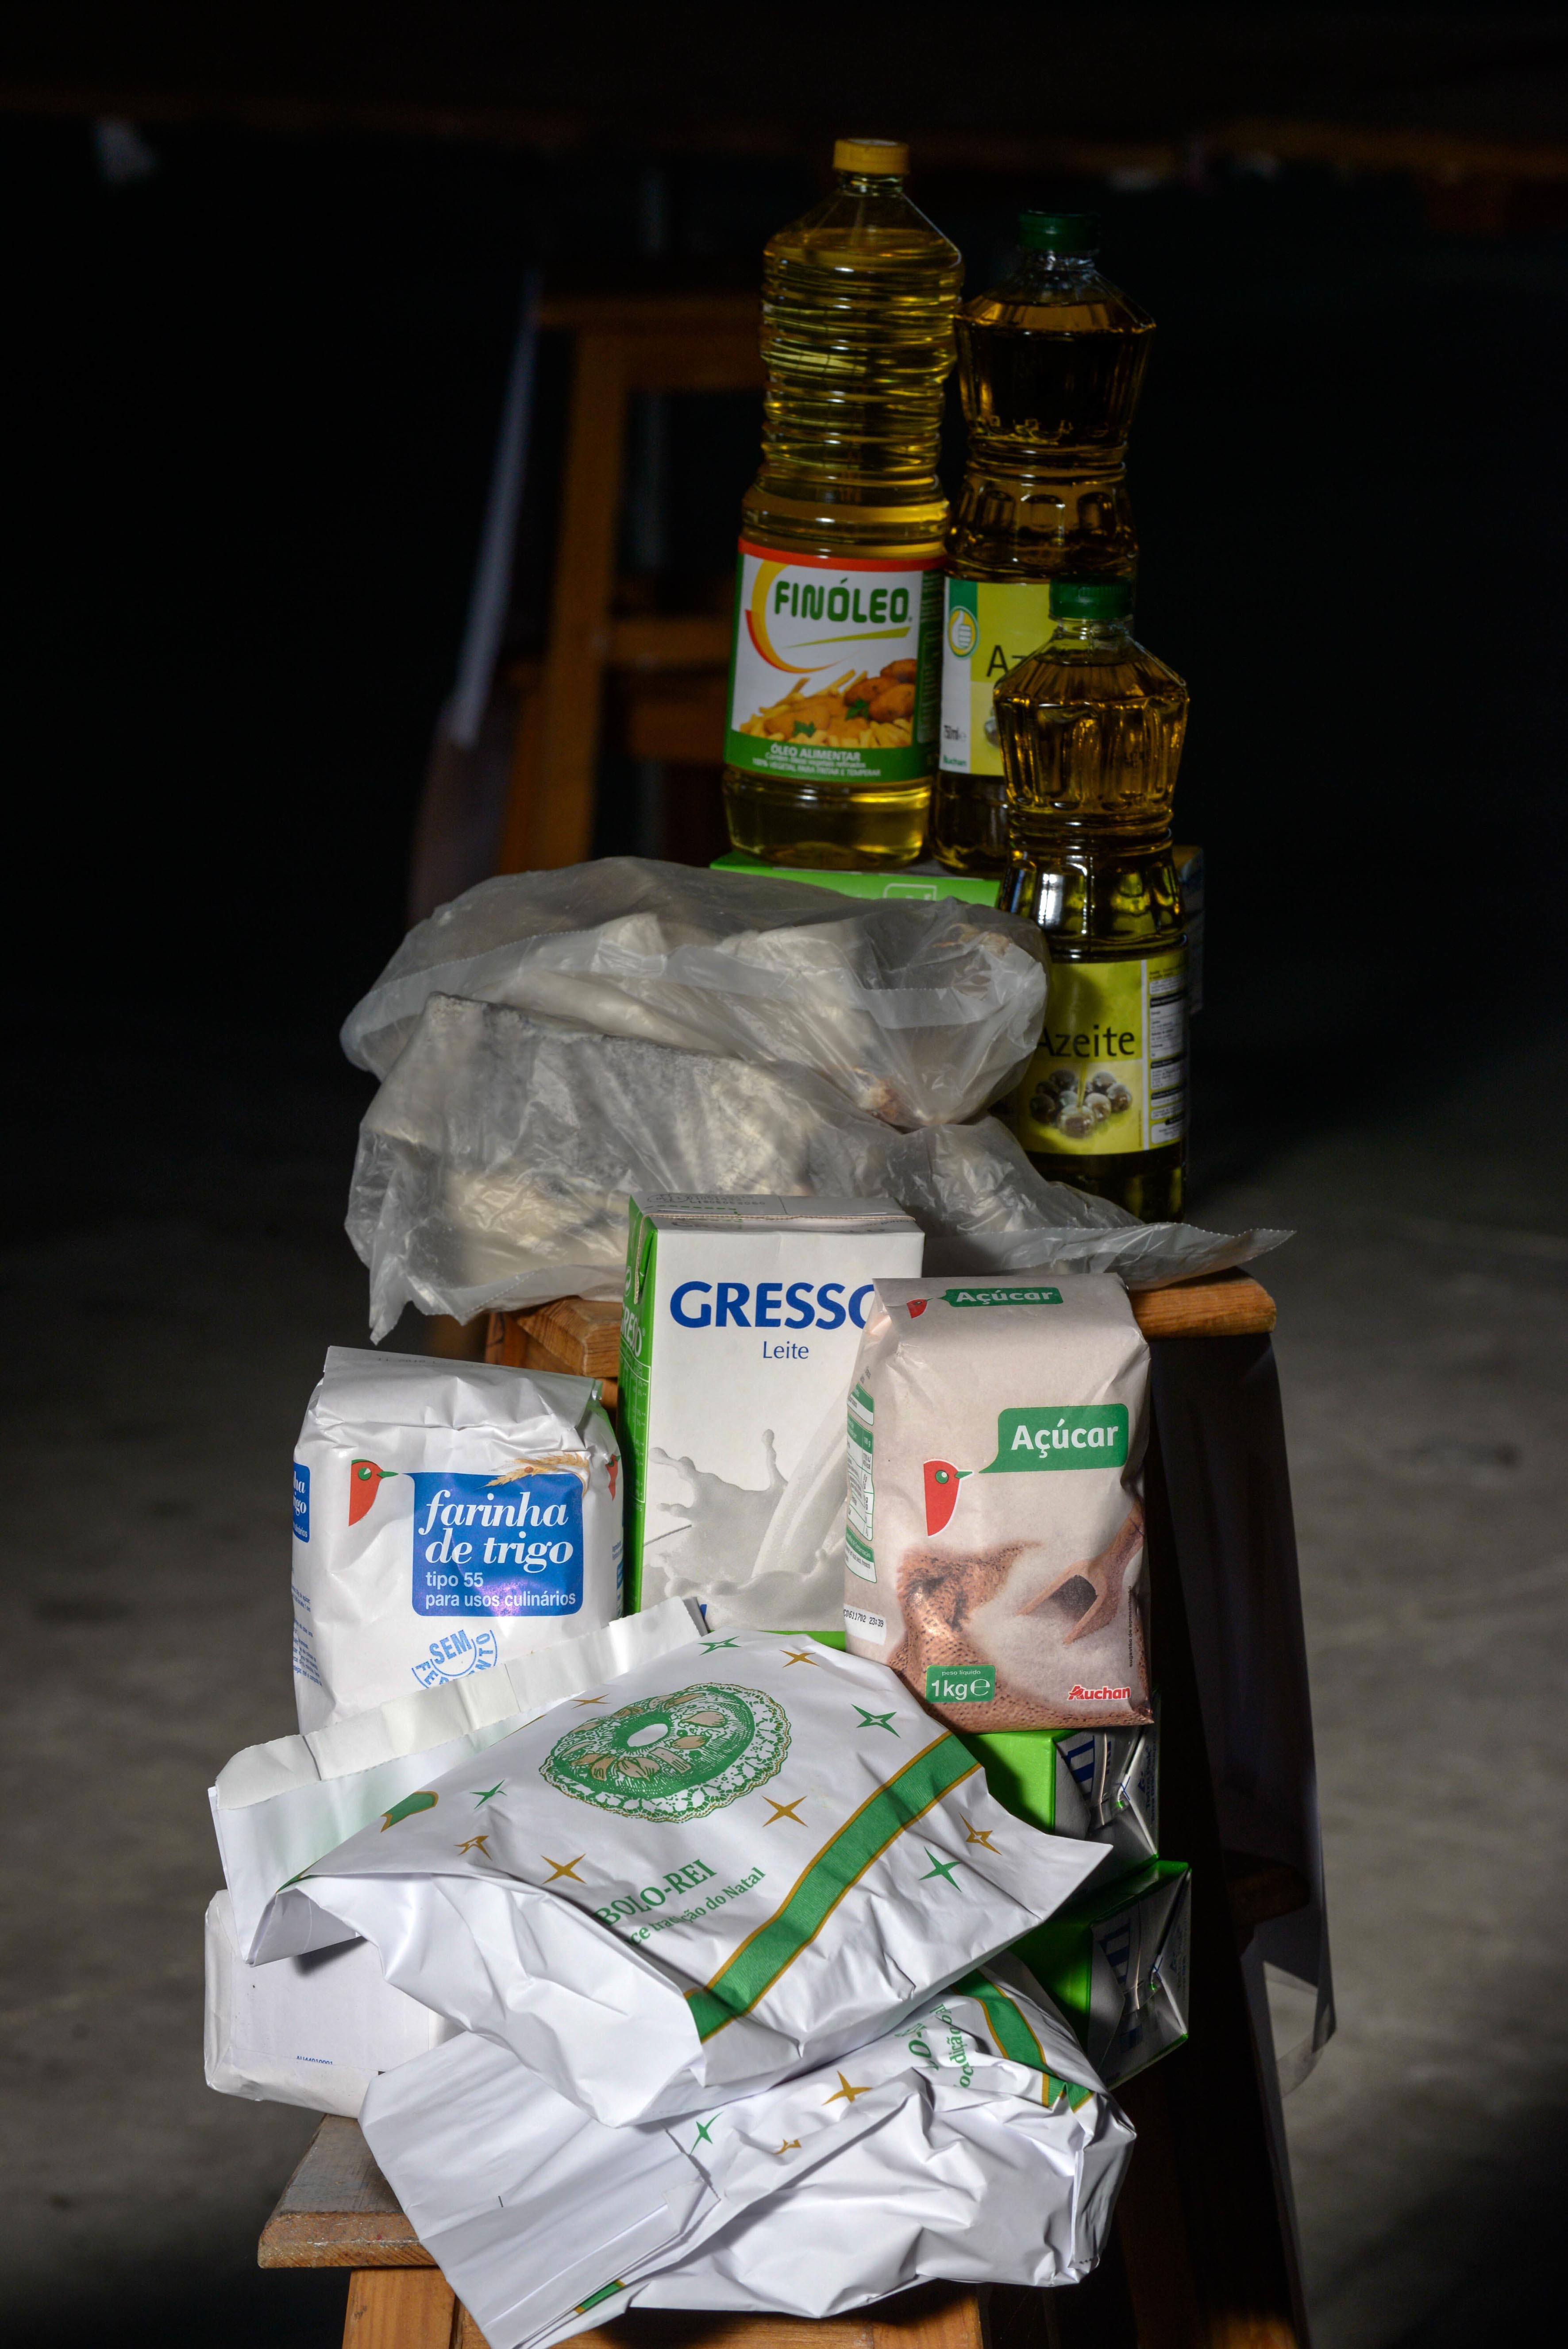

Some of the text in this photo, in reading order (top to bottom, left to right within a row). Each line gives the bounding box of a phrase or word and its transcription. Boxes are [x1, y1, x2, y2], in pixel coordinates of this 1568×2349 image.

[774, 578, 909, 623] FINÓLEO
[771, 742, 861, 762] ÓLEO ALIMENTAR
[956, 1289, 1053, 1305] Açúcar
[763, 1340, 809, 1359] Leite
[1011, 1418, 1118, 1458] Açúcar
[419, 1490, 568, 1535] farinha
[425, 1528, 472, 1564] de
[483, 1531, 574, 1573] trigo
[425, 1571, 484, 1588] tipo 55
[425, 1590, 576, 1609] para usos culinários
[429, 1629, 472, 1665] SEM
[1067, 1685, 1131, 1701] Auchan
[594, 1859, 717, 1926] BOLO-REI
[651, 1902, 707, 1931] tradição
[705, 1891, 727, 1911] do
[723, 1867, 767, 1898] Natal
